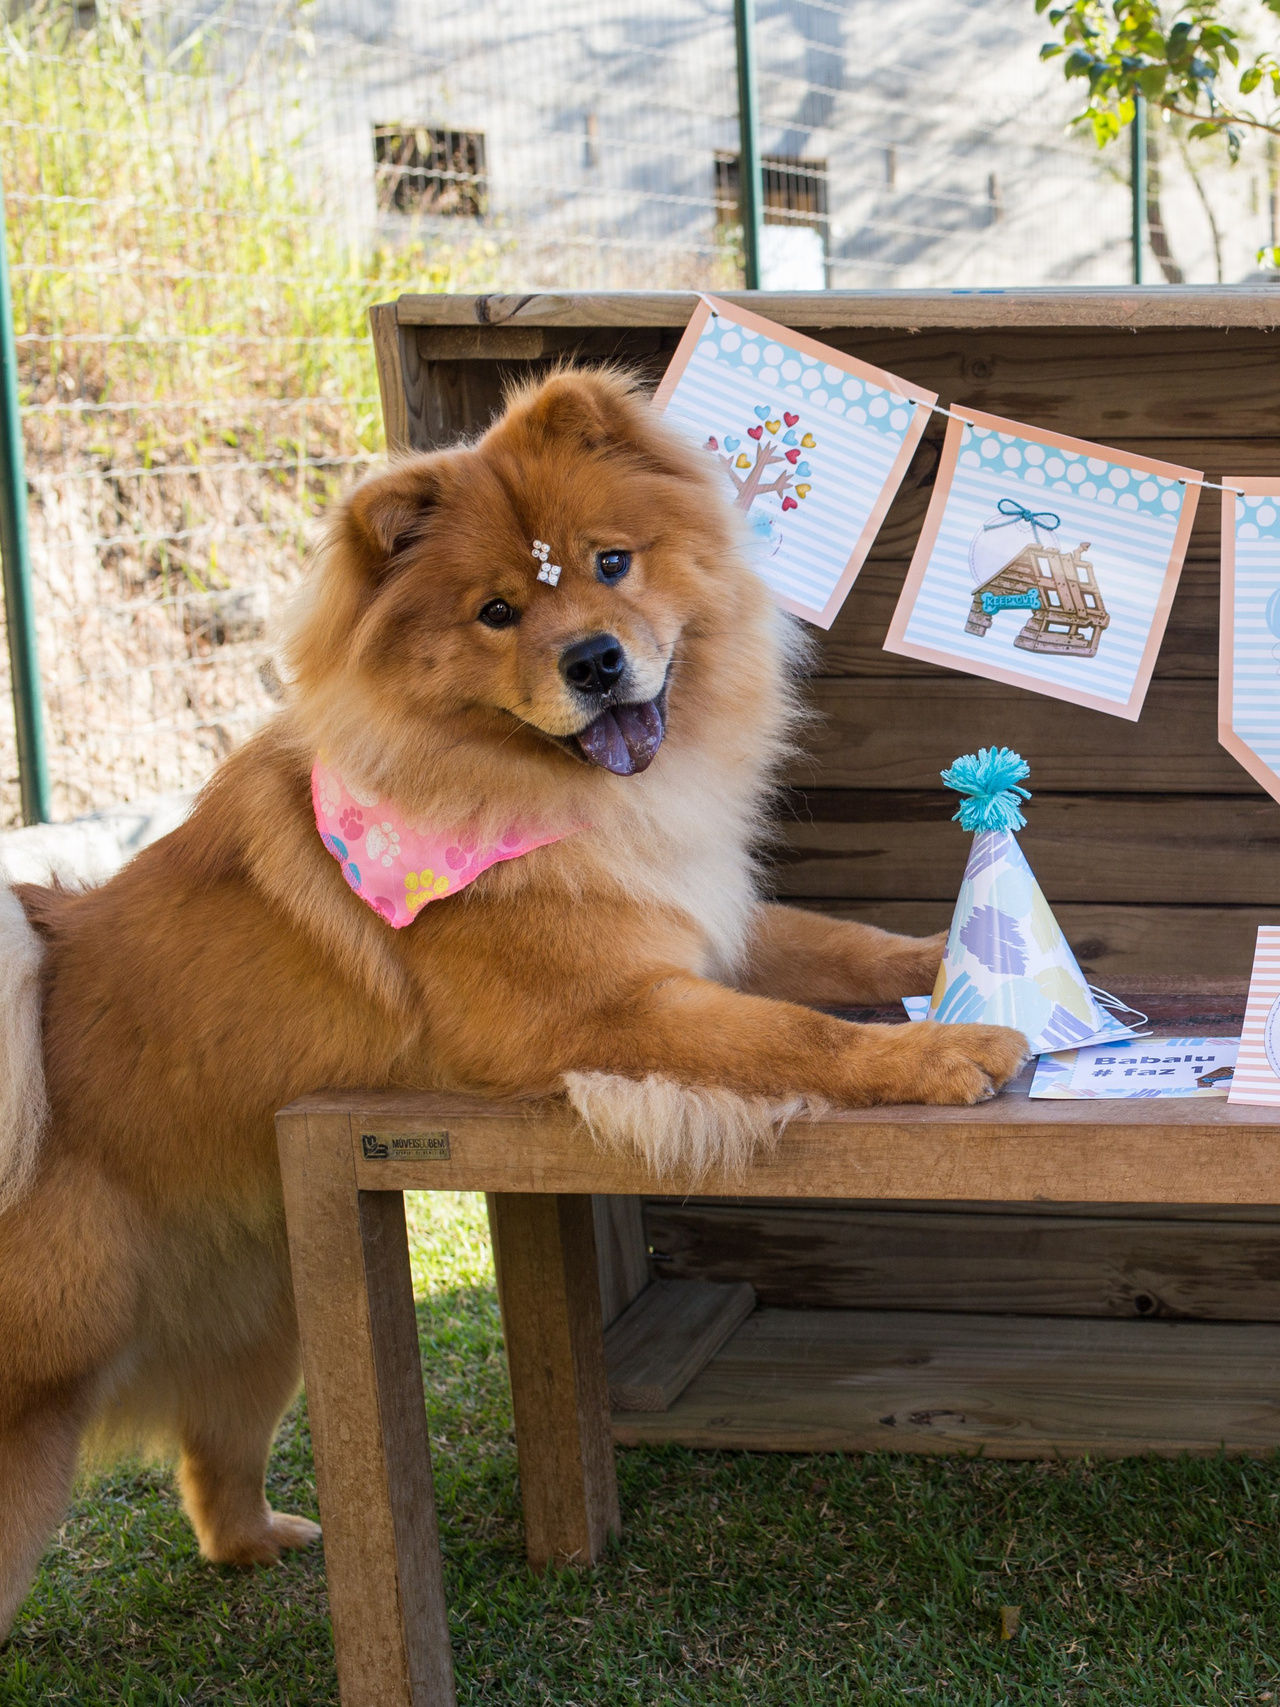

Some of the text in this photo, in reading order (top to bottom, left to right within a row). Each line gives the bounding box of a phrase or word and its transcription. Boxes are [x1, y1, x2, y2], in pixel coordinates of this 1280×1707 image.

[985, 594, 1035, 606] KEEP OUT
[1094, 1055, 1216, 1066] Babalu
[1124, 1067, 1176, 1077] faz
[1190, 1066, 1204, 1074] 1
